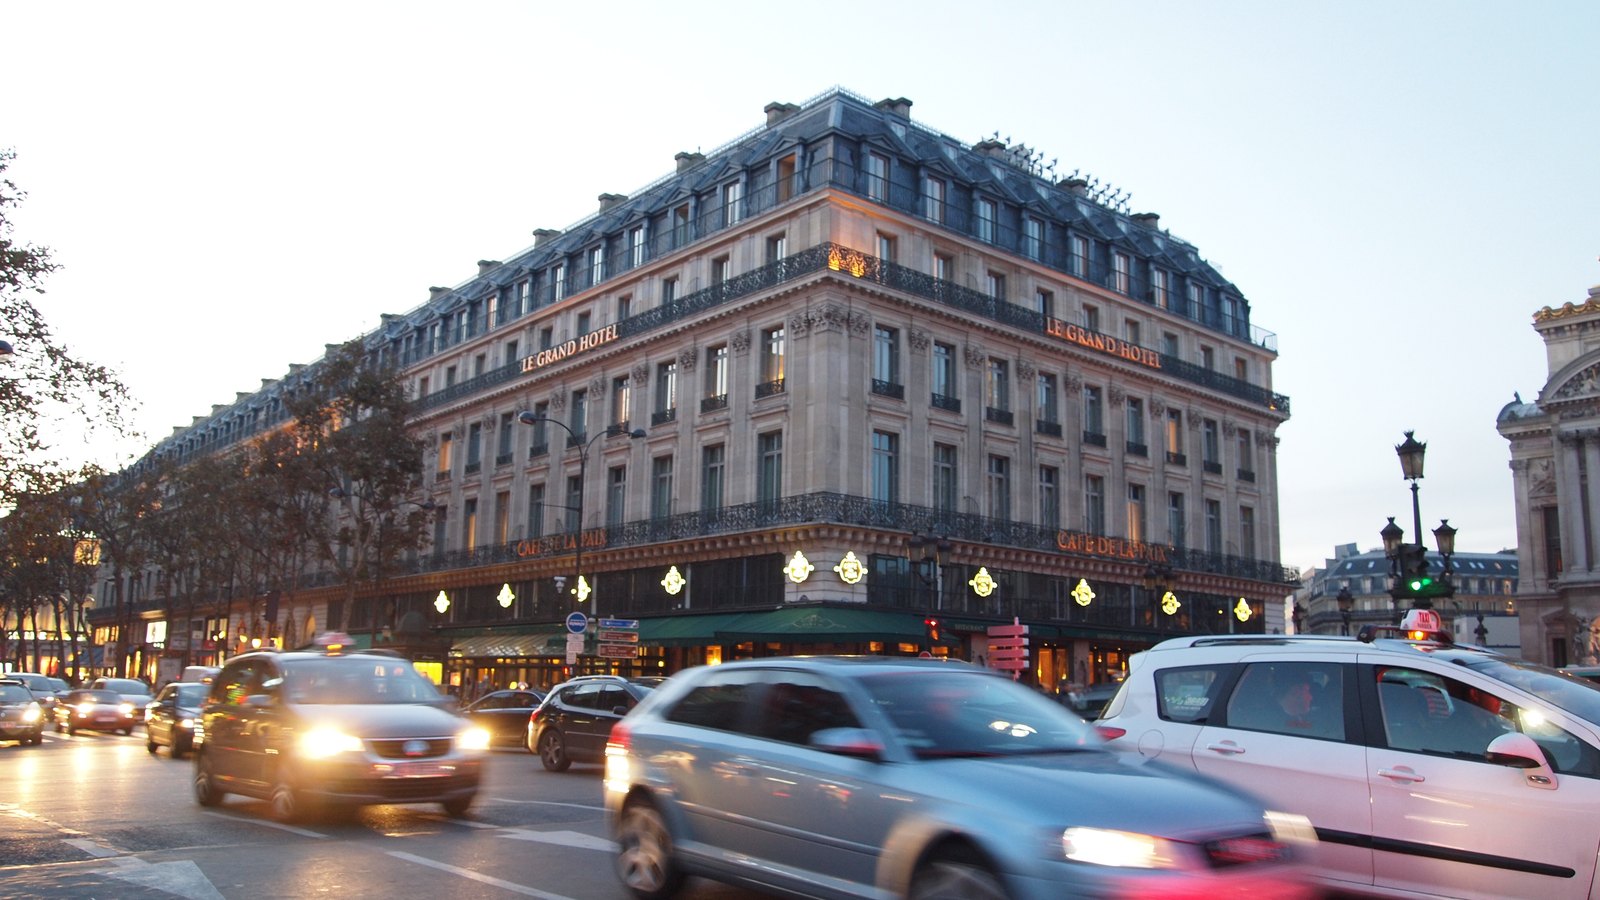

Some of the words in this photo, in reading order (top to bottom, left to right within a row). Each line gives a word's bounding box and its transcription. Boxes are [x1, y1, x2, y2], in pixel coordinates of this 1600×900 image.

[522, 355, 535, 372] LE
[536, 339, 576, 367] GRAND
[579, 324, 619, 352] HOTEL
[1046, 316, 1061, 336] LE
[1066, 324, 1116, 352] GRAND
[1120, 341, 1162, 368] HOTEL
[563, 533, 577, 549] LA
[1098, 536, 1116, 555] DE
[1119, 540, 1135, 559] LA
